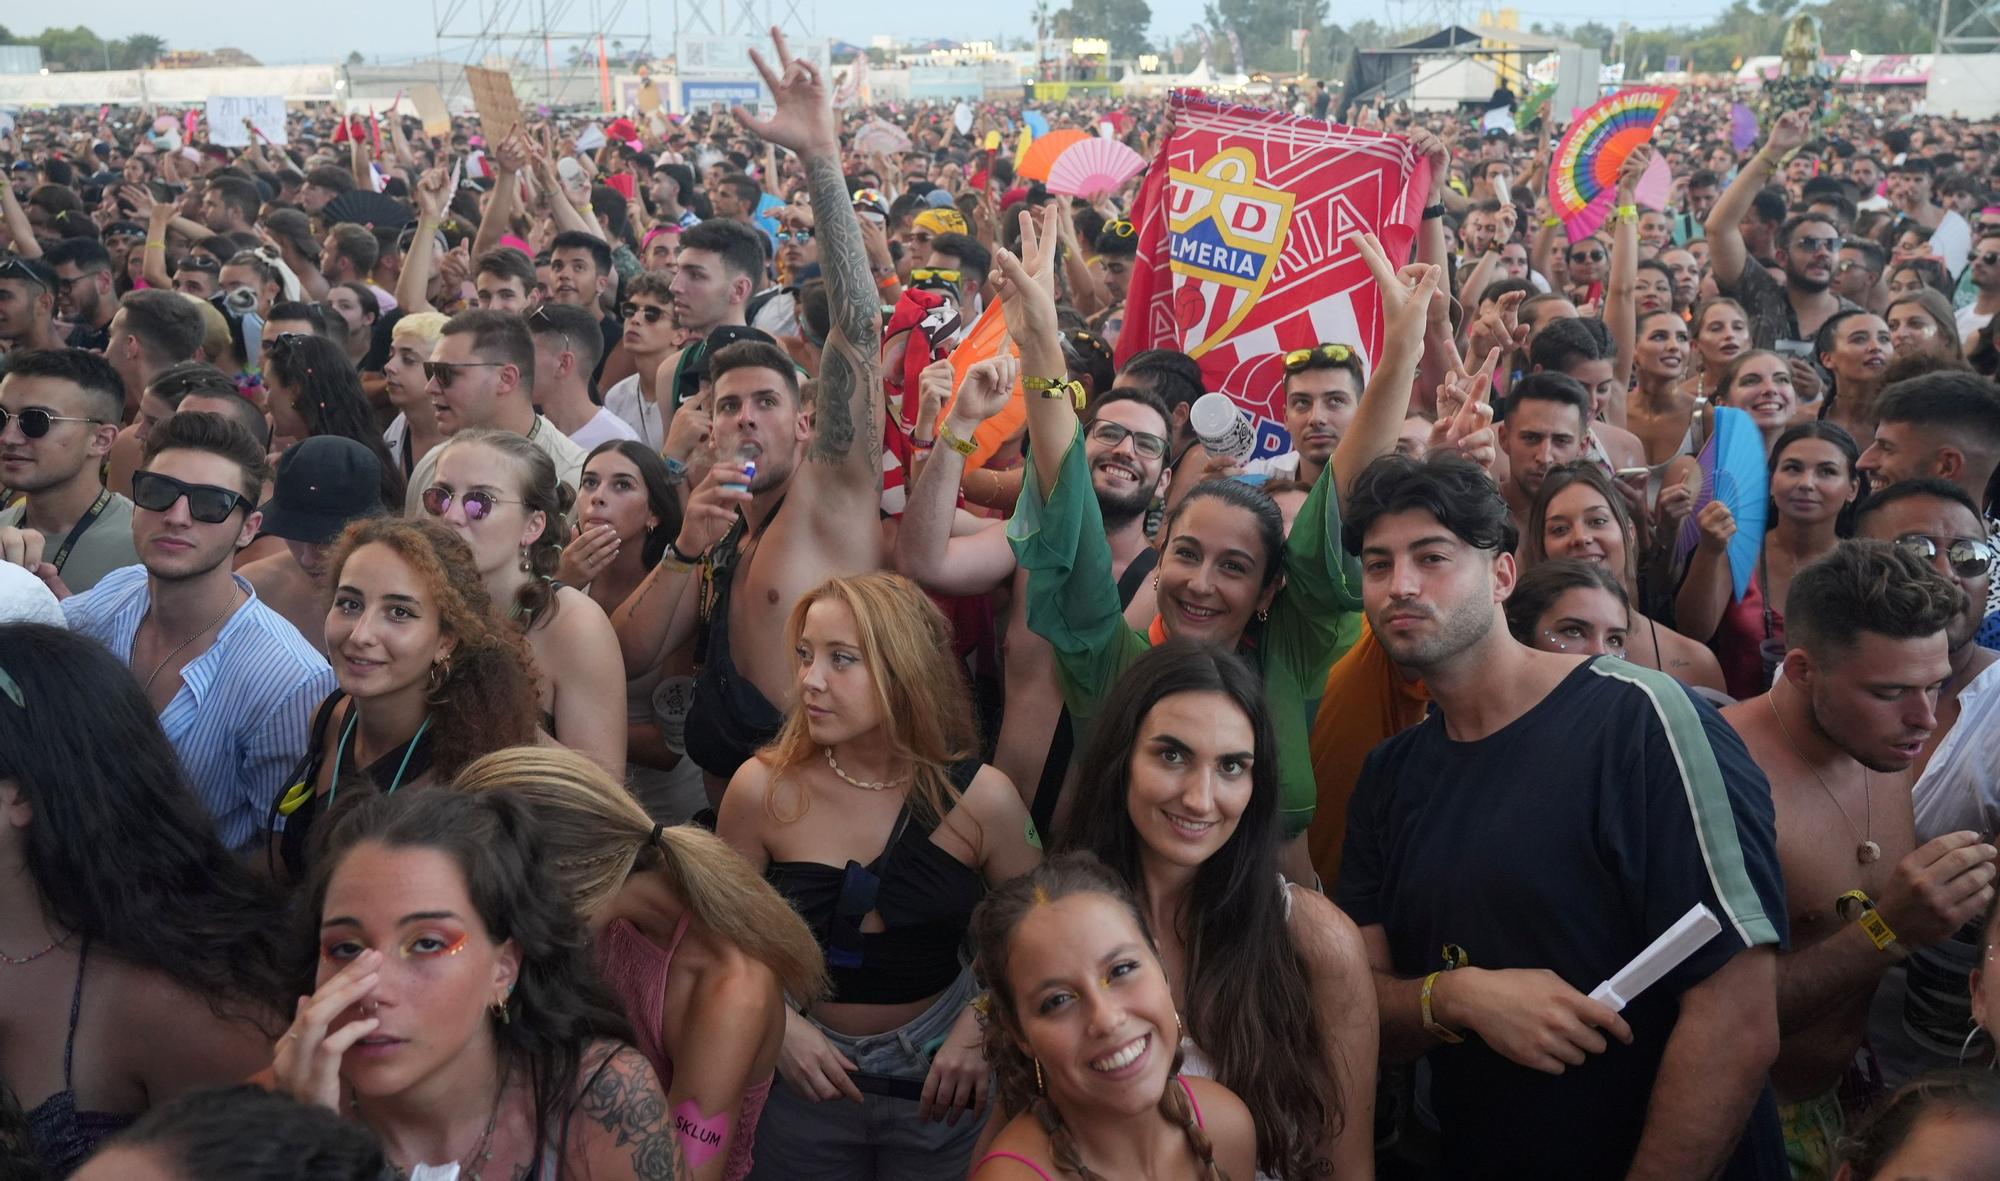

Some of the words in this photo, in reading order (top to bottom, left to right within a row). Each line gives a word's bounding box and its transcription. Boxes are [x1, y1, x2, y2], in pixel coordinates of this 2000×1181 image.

[1231, 202, 1267, 233] D
[1170, 234, 1255, 278] LMERIA
[675, 1115, 721, 1148] SKLUM
